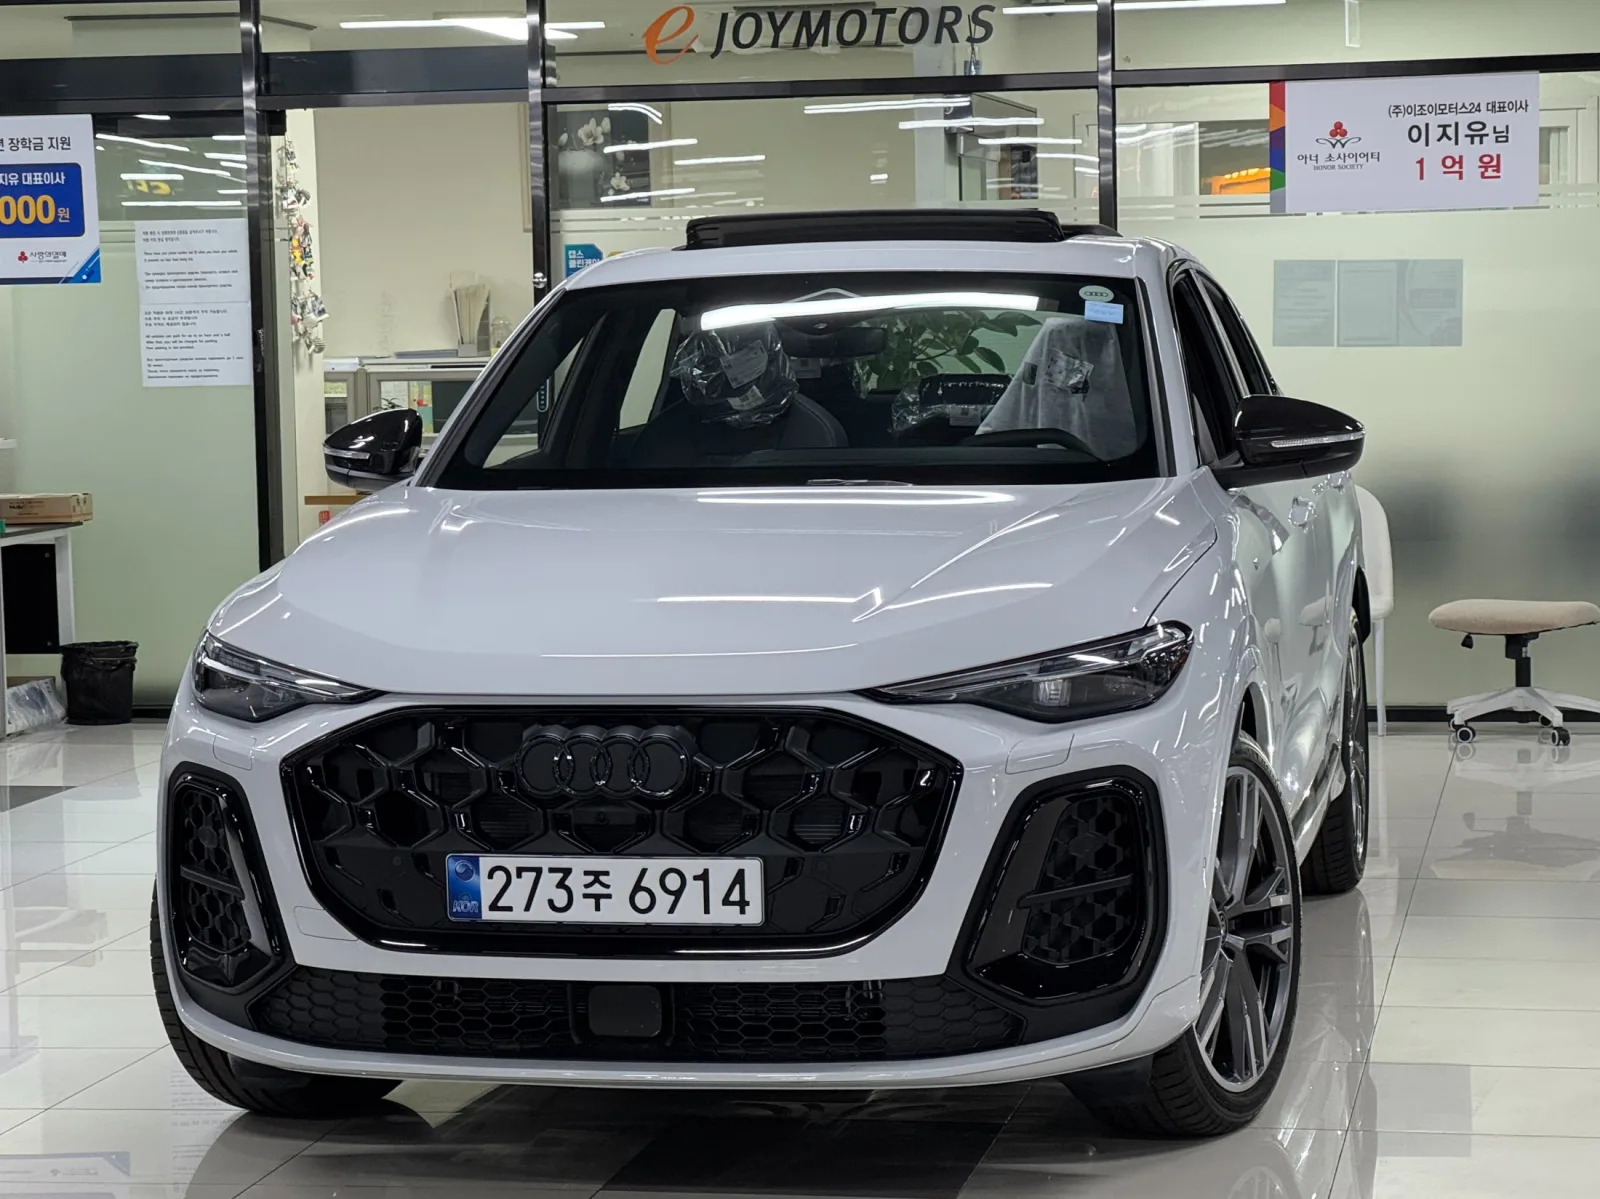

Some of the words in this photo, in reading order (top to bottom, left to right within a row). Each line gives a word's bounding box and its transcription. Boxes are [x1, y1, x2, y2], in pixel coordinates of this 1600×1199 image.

[710, 4, 996, 59] JOYMOTORS
[1388, 102, 1482, 118] (주)이조이모터스24
[1486, 99, 1529, 114] 대표이사
[8, 137, 44, 152] 장학금
[48, 136, 71, 151] 지원
[1297, 153, 1319, 165] 아너
[1324, 151, 1380, 163] 소사이어티
[22, 171, 66, 186] 대표이사
[487, 865, 612, 914] 273주
[628, 867, 750, 915] 6914
[452, 899, 479, 913] KOR
